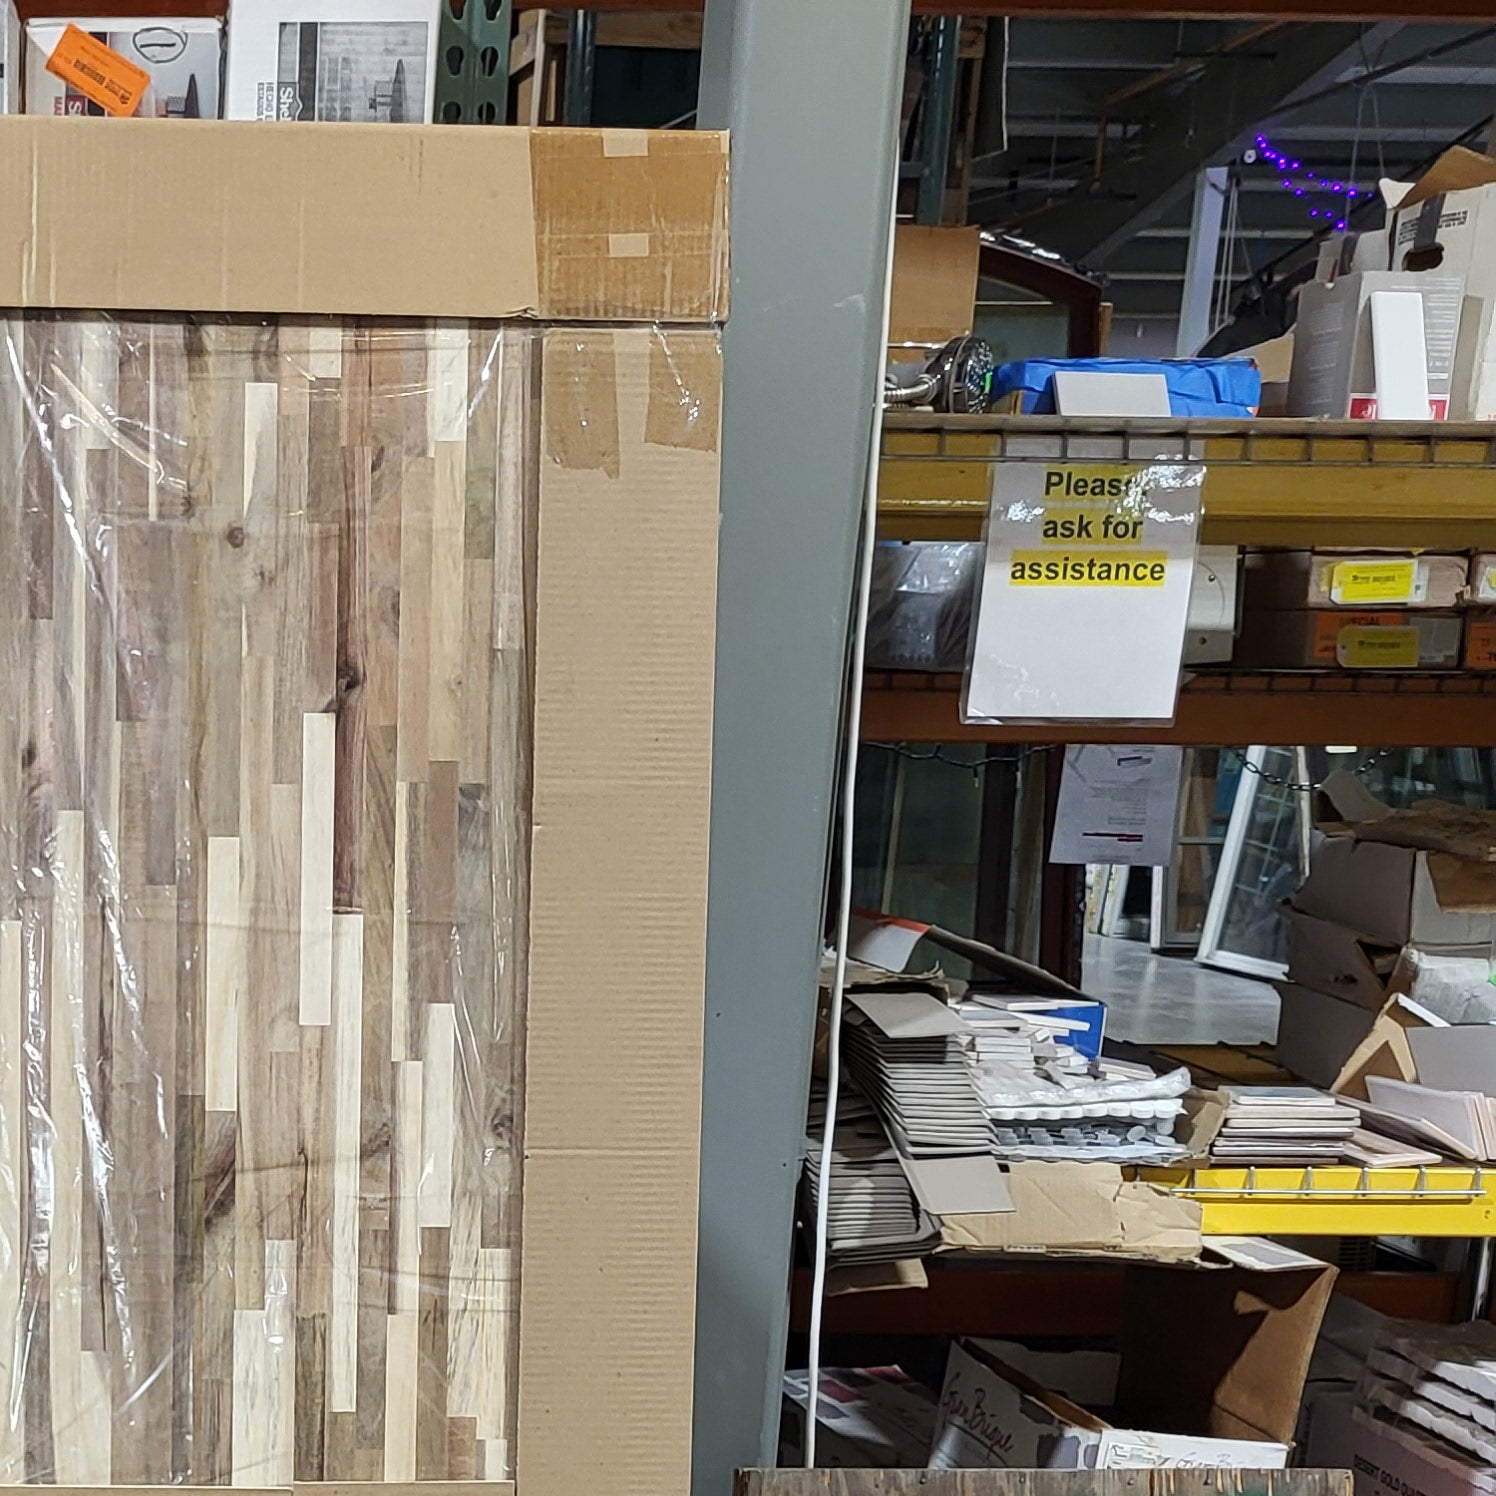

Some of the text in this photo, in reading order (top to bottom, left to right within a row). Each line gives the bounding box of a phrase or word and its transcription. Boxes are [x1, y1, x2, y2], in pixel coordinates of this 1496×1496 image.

[1043, 514, 1144, 539] ask for
[1011, 557, 1165, 581] assistance
